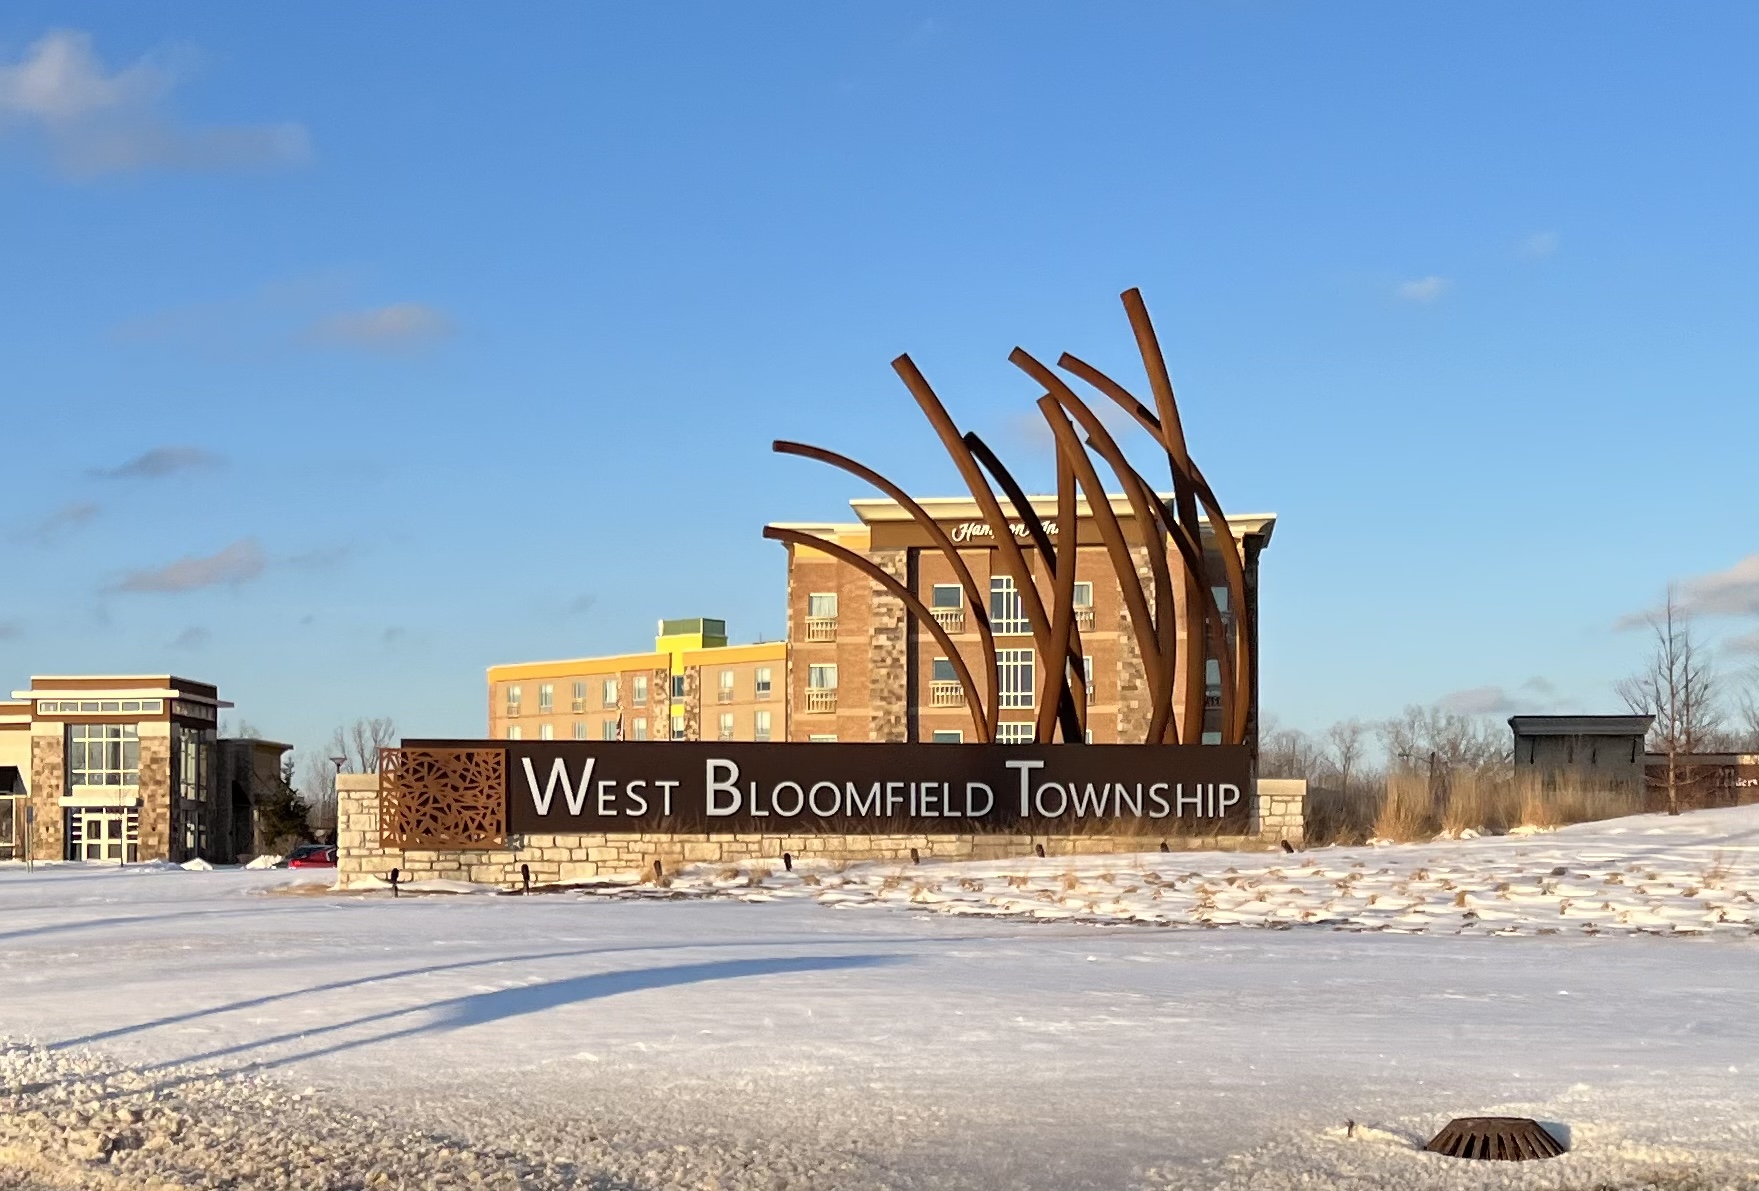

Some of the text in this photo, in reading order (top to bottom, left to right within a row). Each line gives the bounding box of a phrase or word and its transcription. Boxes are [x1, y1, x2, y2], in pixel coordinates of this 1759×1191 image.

[952, 520, 1061, 543] Hamon In
[521, 757, 1241, 818] WEST BLOOMFIELD TOWNSHIP
